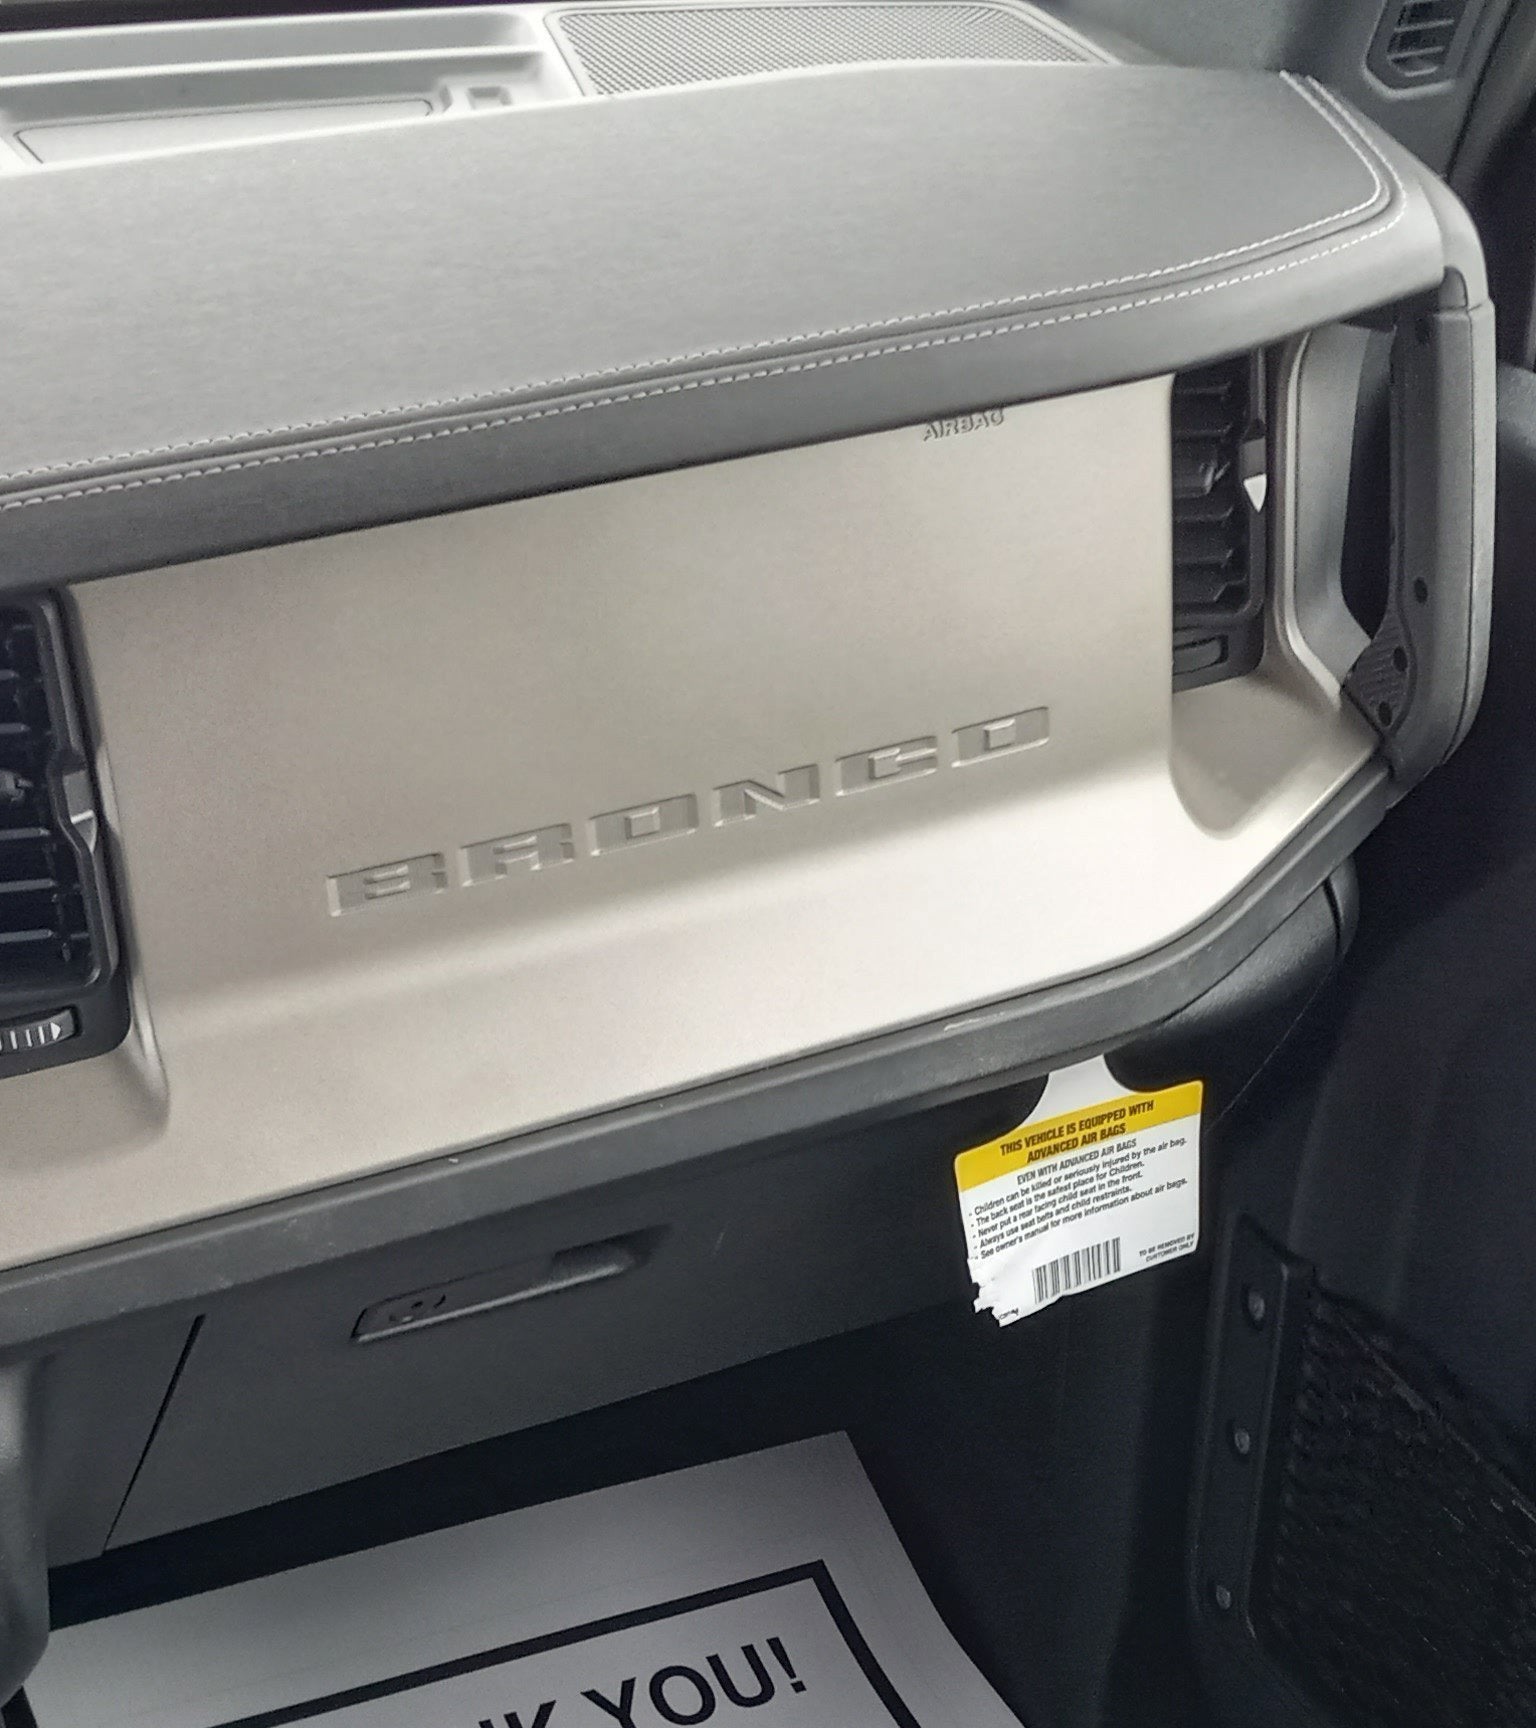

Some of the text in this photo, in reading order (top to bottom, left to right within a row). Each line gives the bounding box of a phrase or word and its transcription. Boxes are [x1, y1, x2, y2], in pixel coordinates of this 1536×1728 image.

[326, 706, 1050, 917] BRONCO
[1000, 1100, 1155, 1156] THIS VEHICLE IS EQUIPPED WITH
[1026, 1122, 1127, 1164] ADVANCED AIR BAGS
[974, 1196, 1005, 1216] Children
[1006, 1192, 1020, 1204] can
[1020, 1185, 1031, 1197] be
[1031, 1178, 1052, 1193] killed
[1063, 1161, 1100, 1182] seriously
[1143, 1144, 1156, 1156] the
[1016, 1138, 1137, 1185] EVEN WITH ADVANCED AIR BAGS
[975, 1214, 990, 1227] The
[991, 1207, 1008, 1220] back
[1033, 1191, 1046, 1203] the
[999, 1217, 1012, 1231] put
[1107, 1177, 1120, 1189] the
[1054, 1204, 1070, 1217] and
